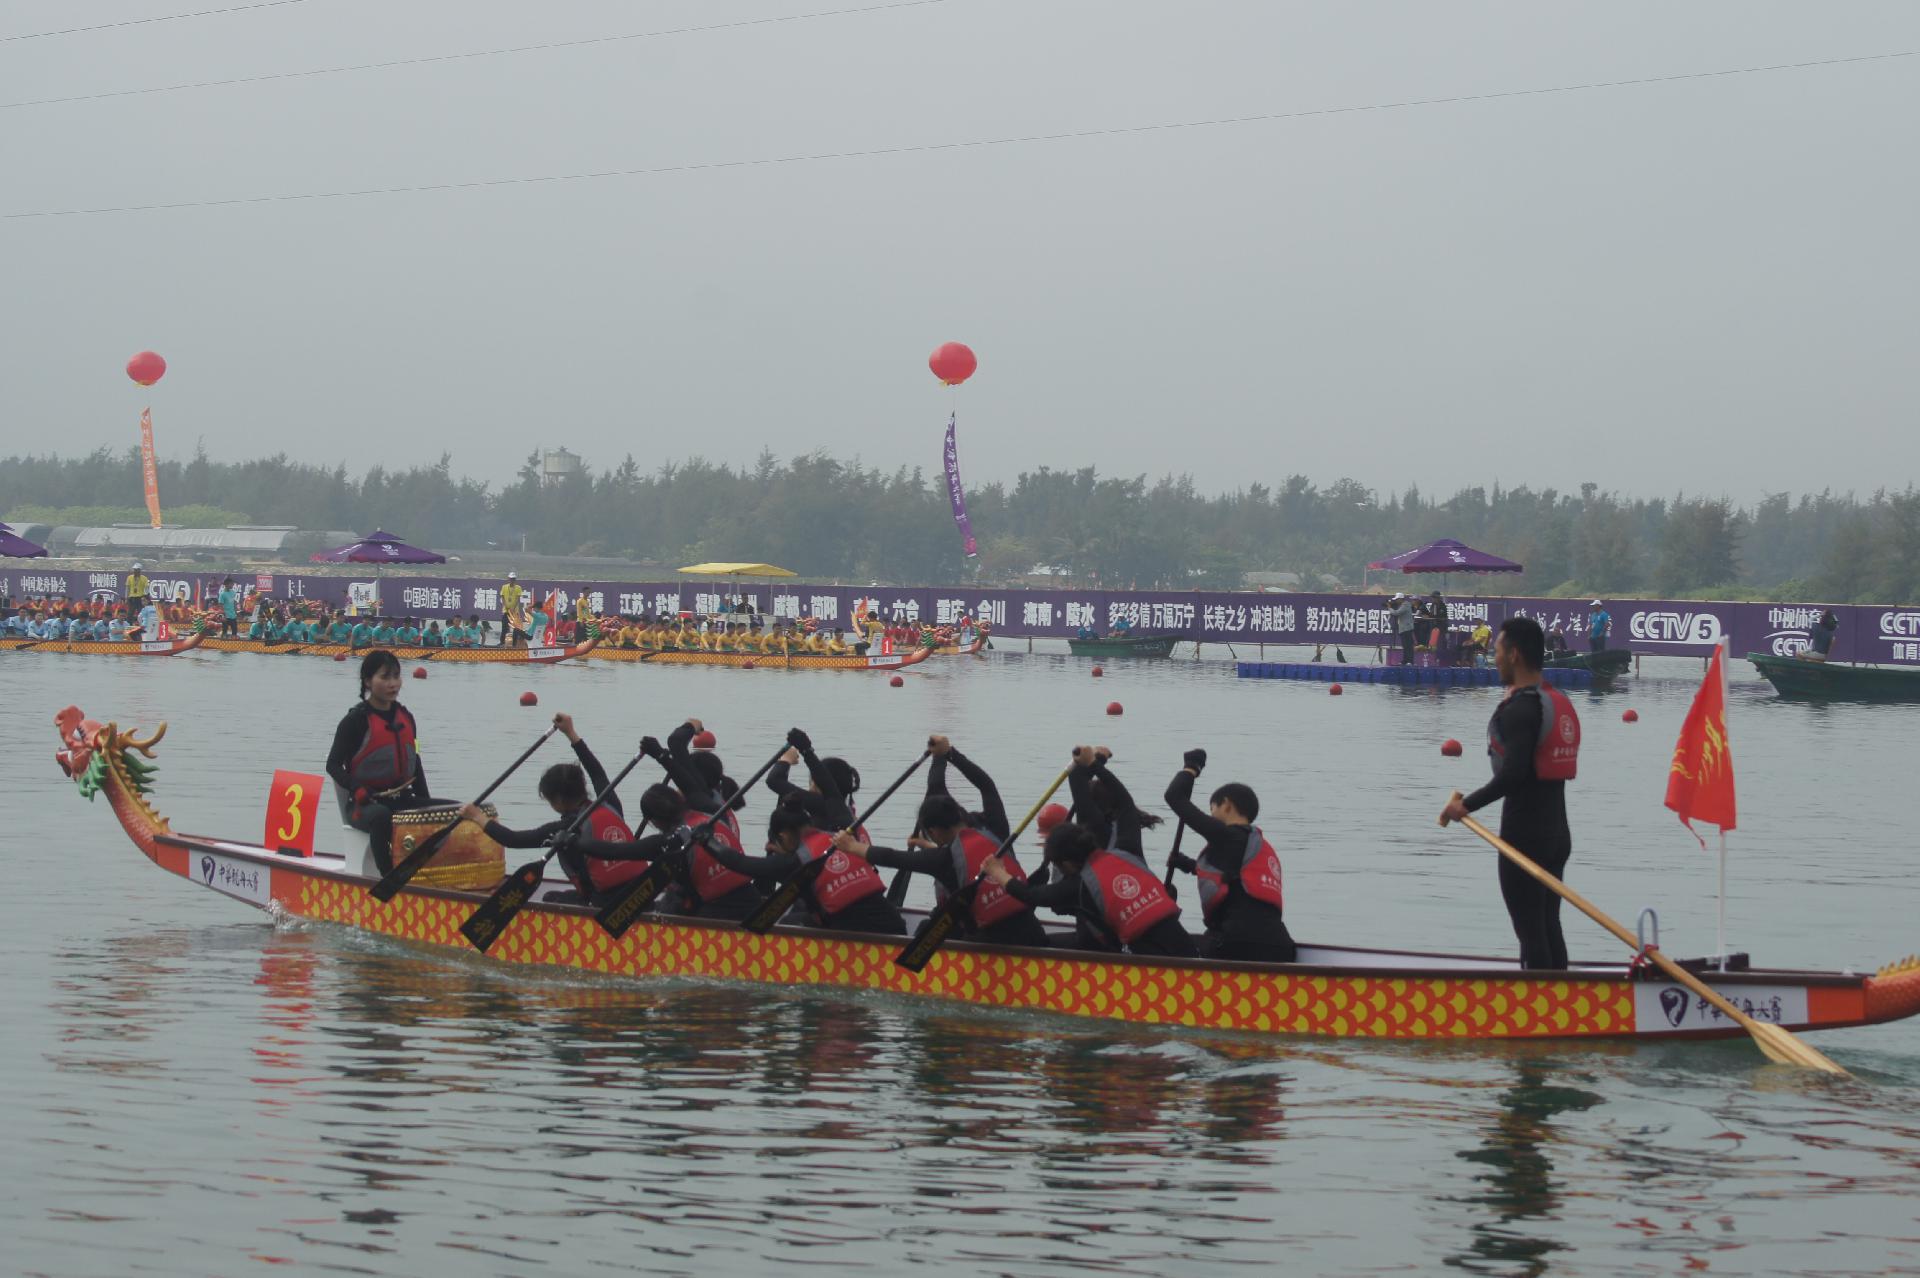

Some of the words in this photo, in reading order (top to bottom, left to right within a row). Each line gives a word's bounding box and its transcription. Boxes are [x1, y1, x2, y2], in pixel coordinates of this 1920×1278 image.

[20, 576, 67, 593] 中国龙舟协会
[89, 573, 117, 588] 中视体育
[1203, 605, 1247, 632] 长寿之乡
[1250, 605, 1296, 632] 冲浪胜地
[1306, 607, 1393, 634] 努力办好自贸区
[160, 624, 166, 639] 3
[547, 631, 553, 645] 2
[883, 640, 889, 654] 1
[278, 784, 303, 841] 3
